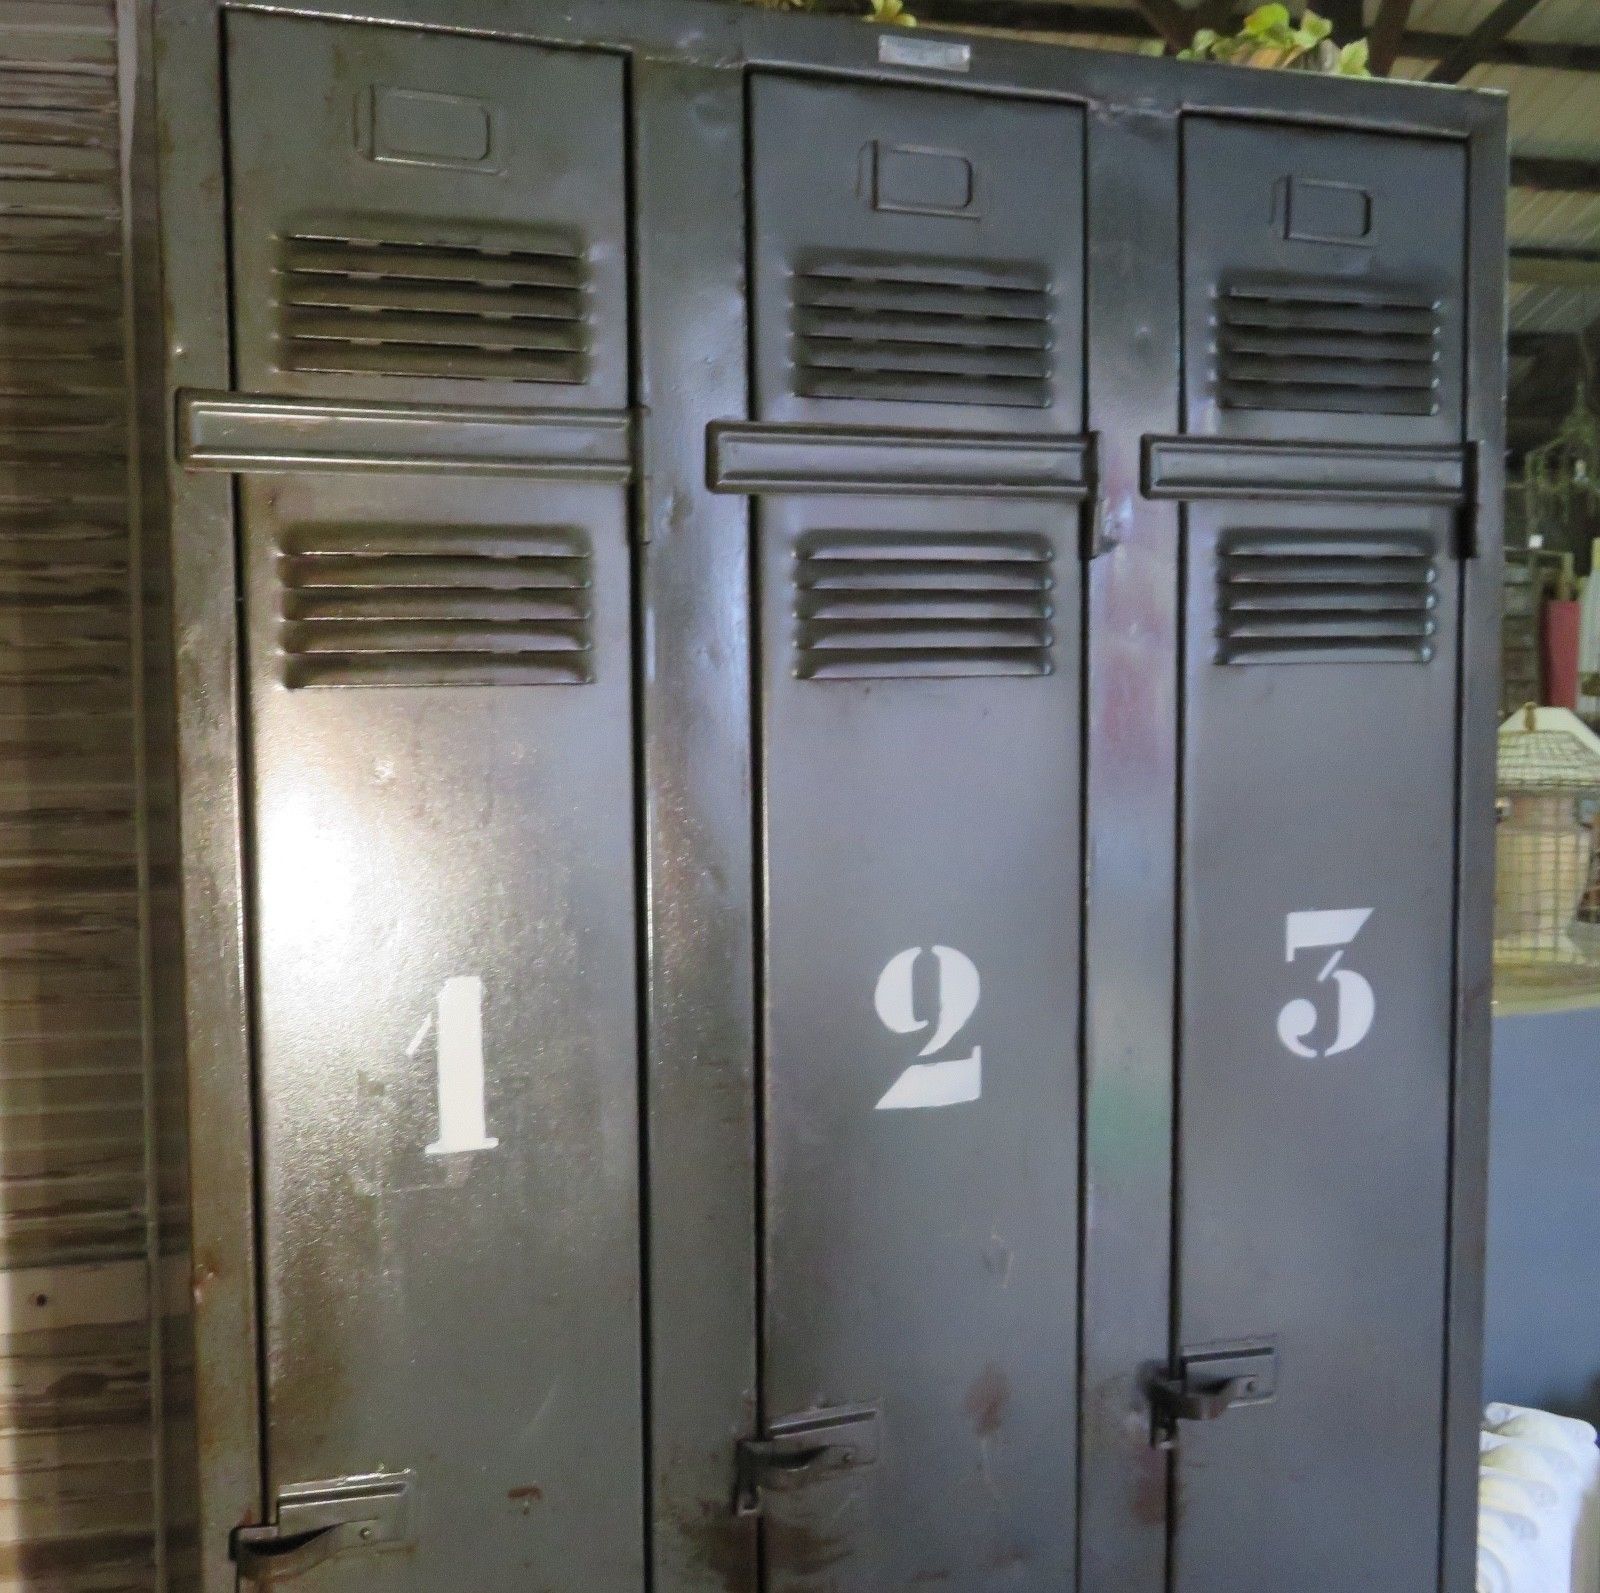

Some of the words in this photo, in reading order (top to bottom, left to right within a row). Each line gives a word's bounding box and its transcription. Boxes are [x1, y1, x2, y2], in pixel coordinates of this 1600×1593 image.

[405, 975, 499, 1154] 1
[873, 944, 982, 1110] 2
[1277, 907, 1376, 1058] 3
